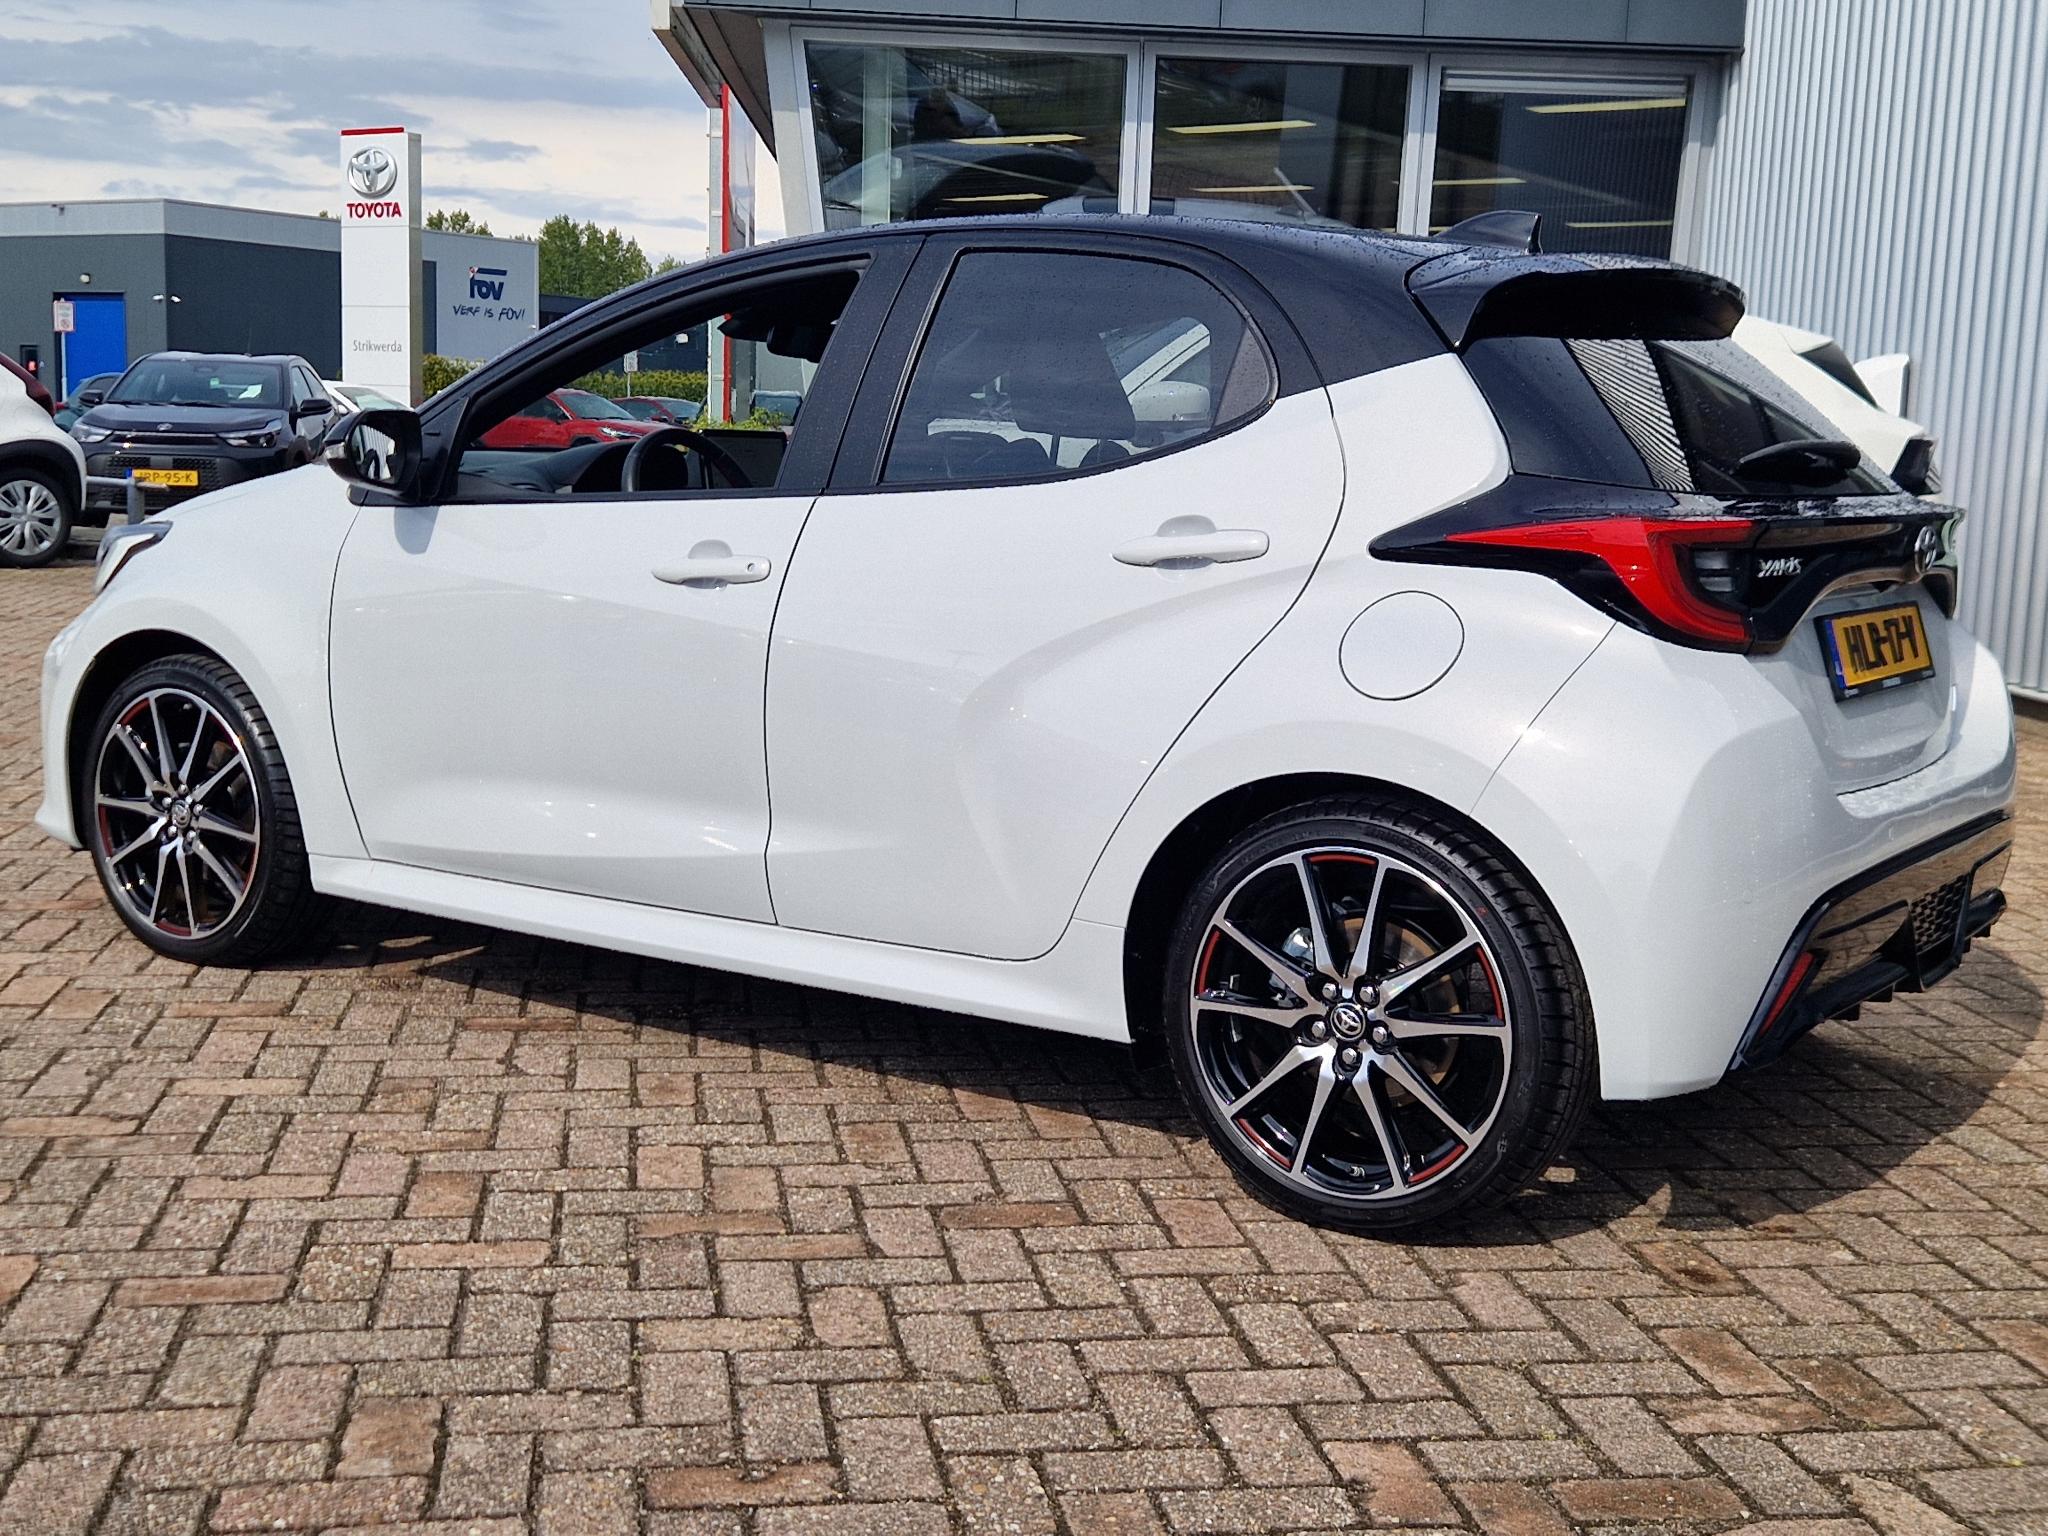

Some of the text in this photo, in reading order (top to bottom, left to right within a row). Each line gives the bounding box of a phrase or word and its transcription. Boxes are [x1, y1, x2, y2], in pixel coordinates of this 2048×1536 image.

[346, 201, 402, 218] TOYOTA
[469, 267, 507, 300] FOV
[453, 304, 480, 316] VERF
[484, 307, 494, 318] IS
[353, 339, 402, 352] Strikwerda
[137, 471, 193, 483] RP-95-K
